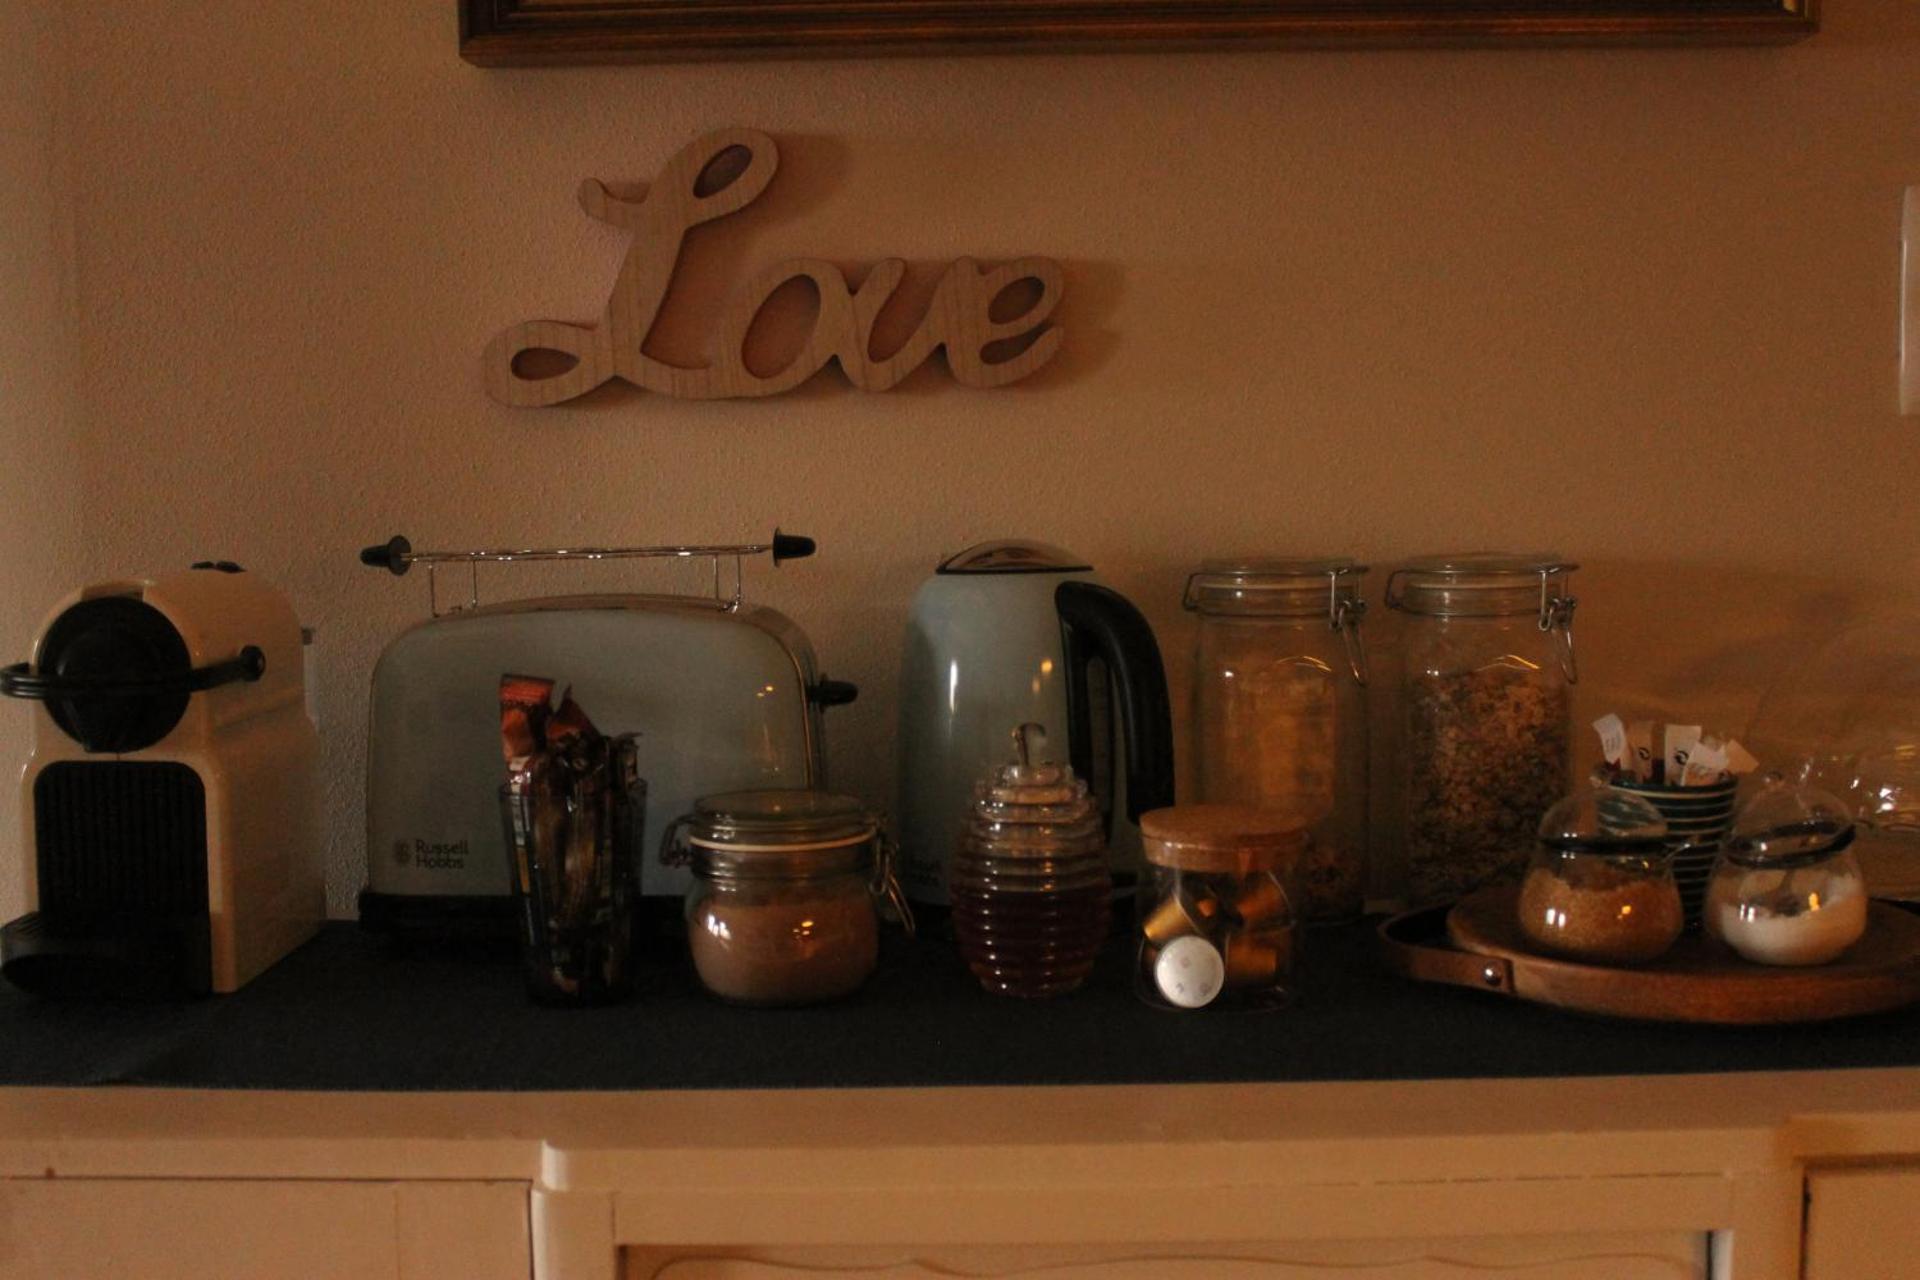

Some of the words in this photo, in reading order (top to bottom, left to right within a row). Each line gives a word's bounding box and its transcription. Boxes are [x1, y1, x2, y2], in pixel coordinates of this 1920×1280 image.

[486, 128, 1066, 408] Love
[415, 839, 469, 854] Russell
[415, 855, 465, 869] Hobbs
